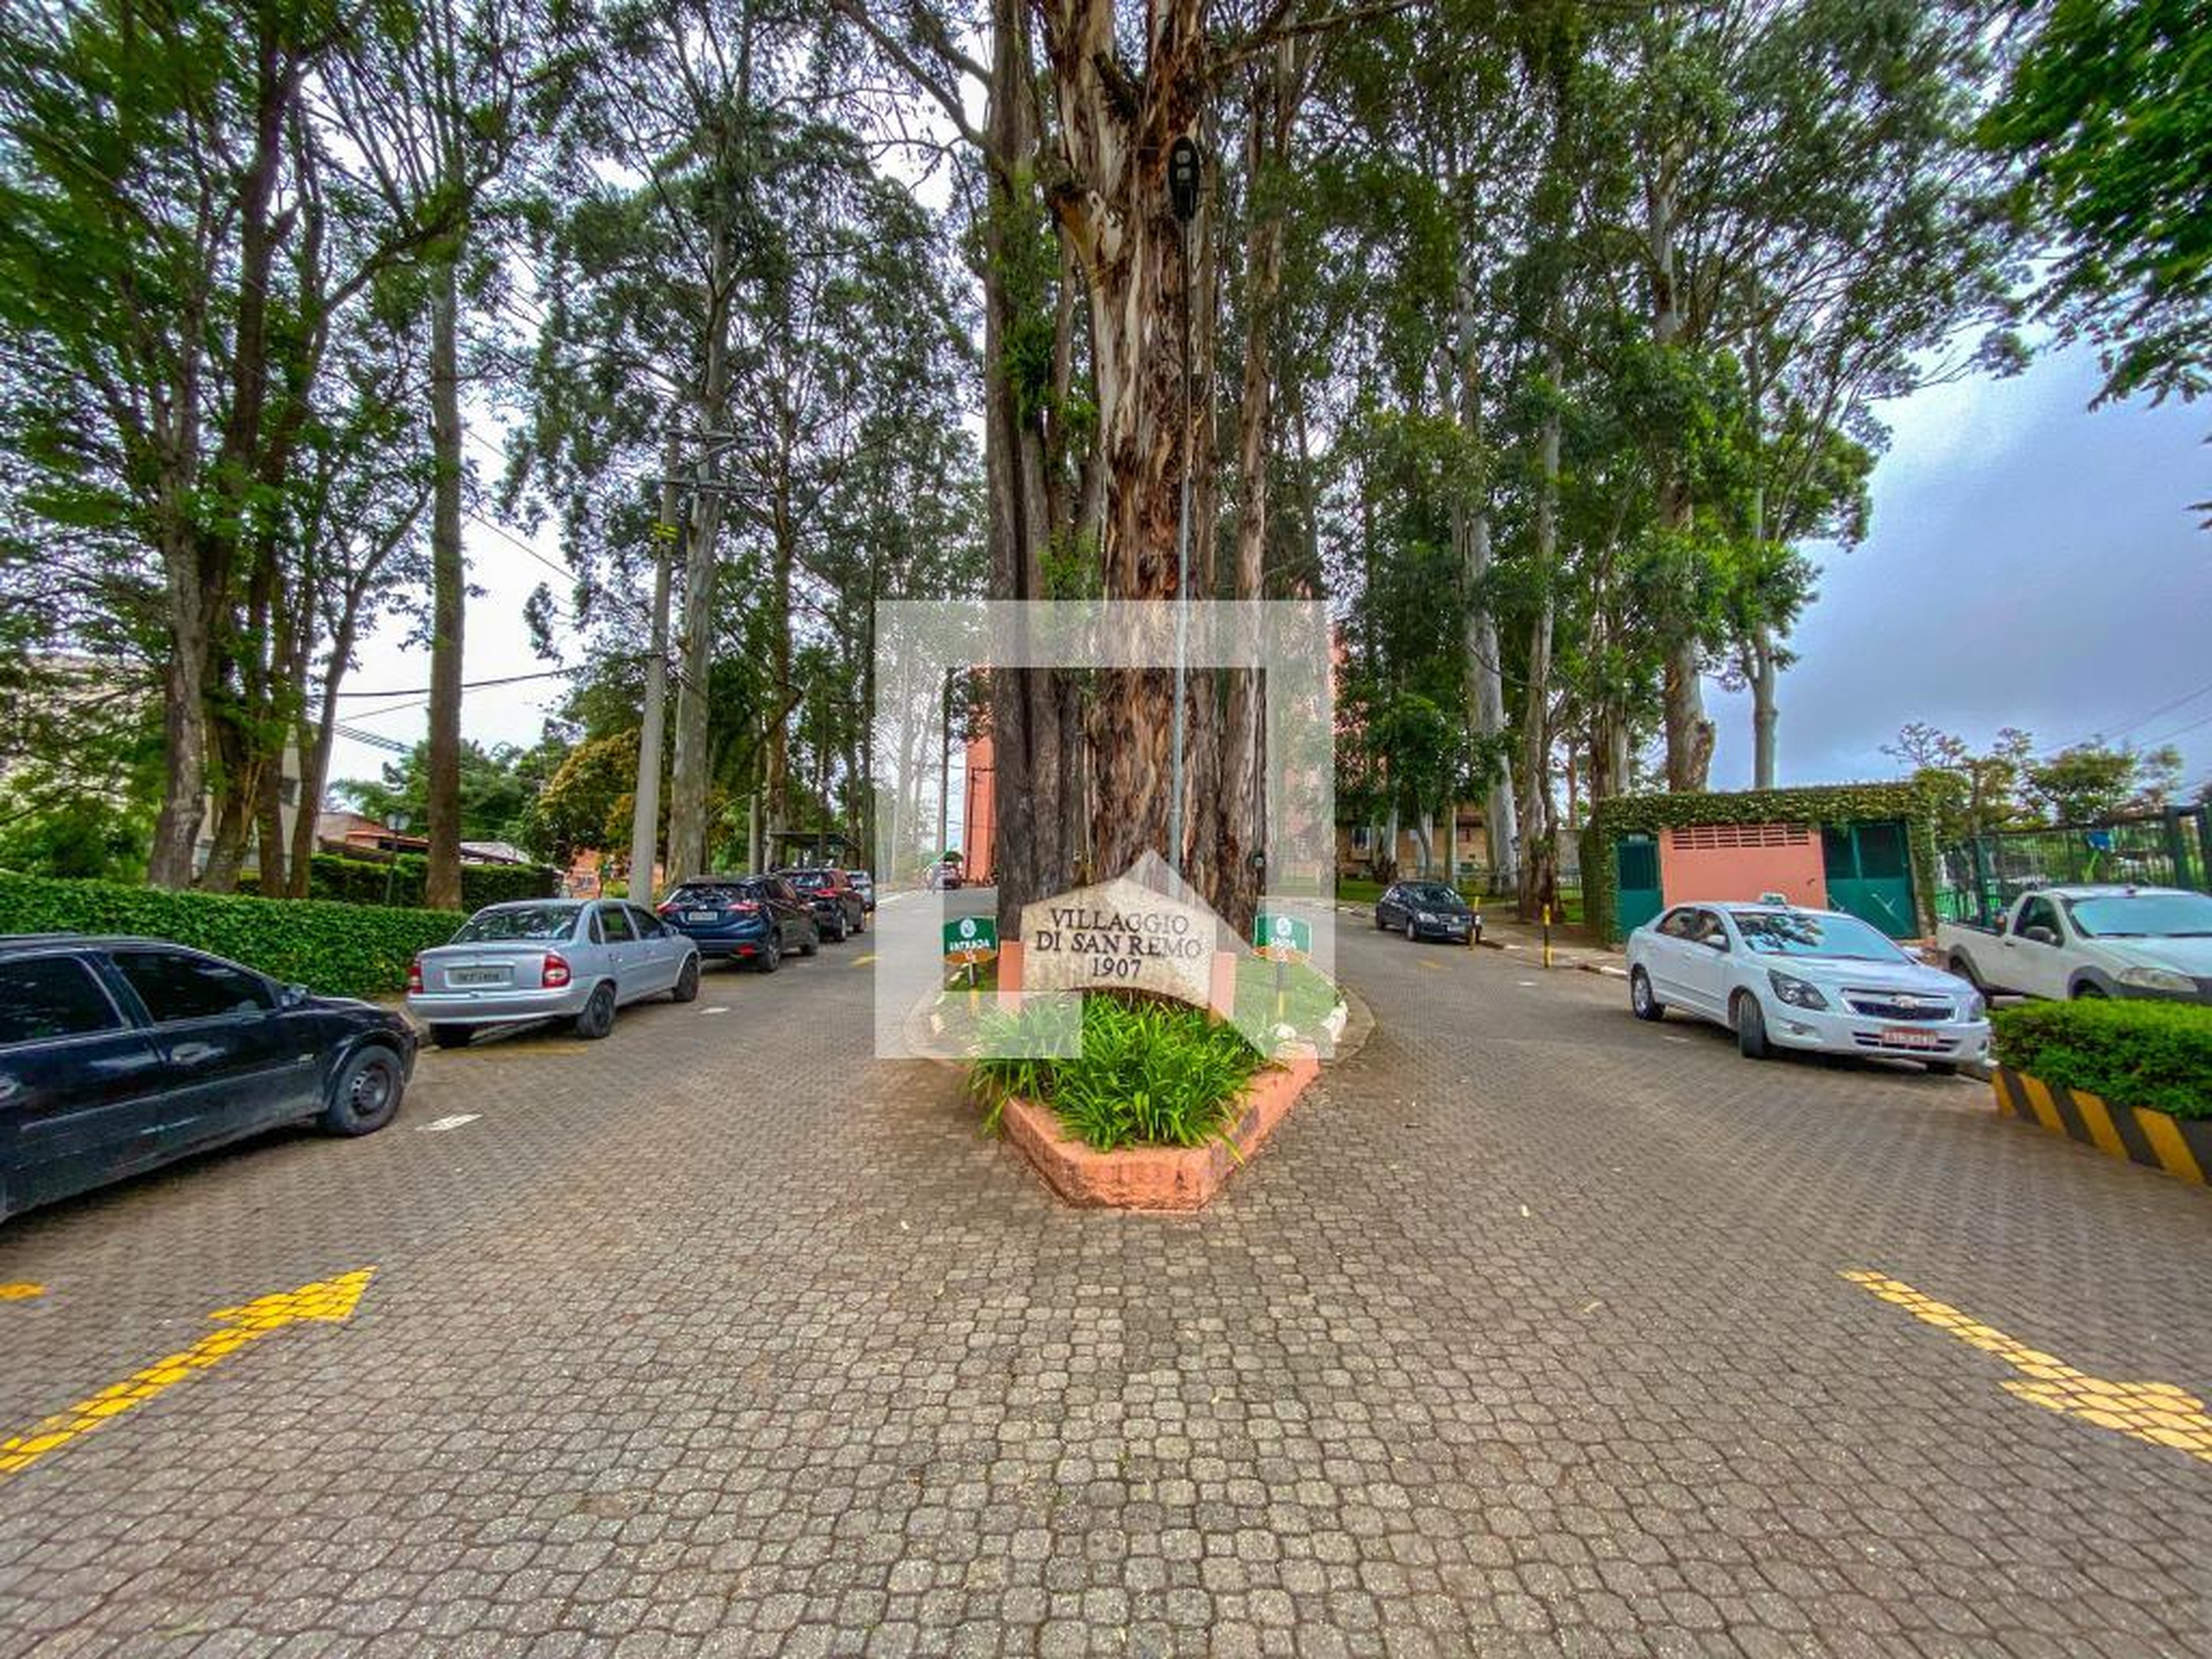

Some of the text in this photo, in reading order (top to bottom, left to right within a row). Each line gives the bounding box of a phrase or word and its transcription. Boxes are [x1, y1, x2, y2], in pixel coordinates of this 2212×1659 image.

[1051, 908, 1190, 935] VILLAGGIO
[1036, 930, 1202, 959] DI SAN REMO
[1092, 957, 1142, 979] 1907
